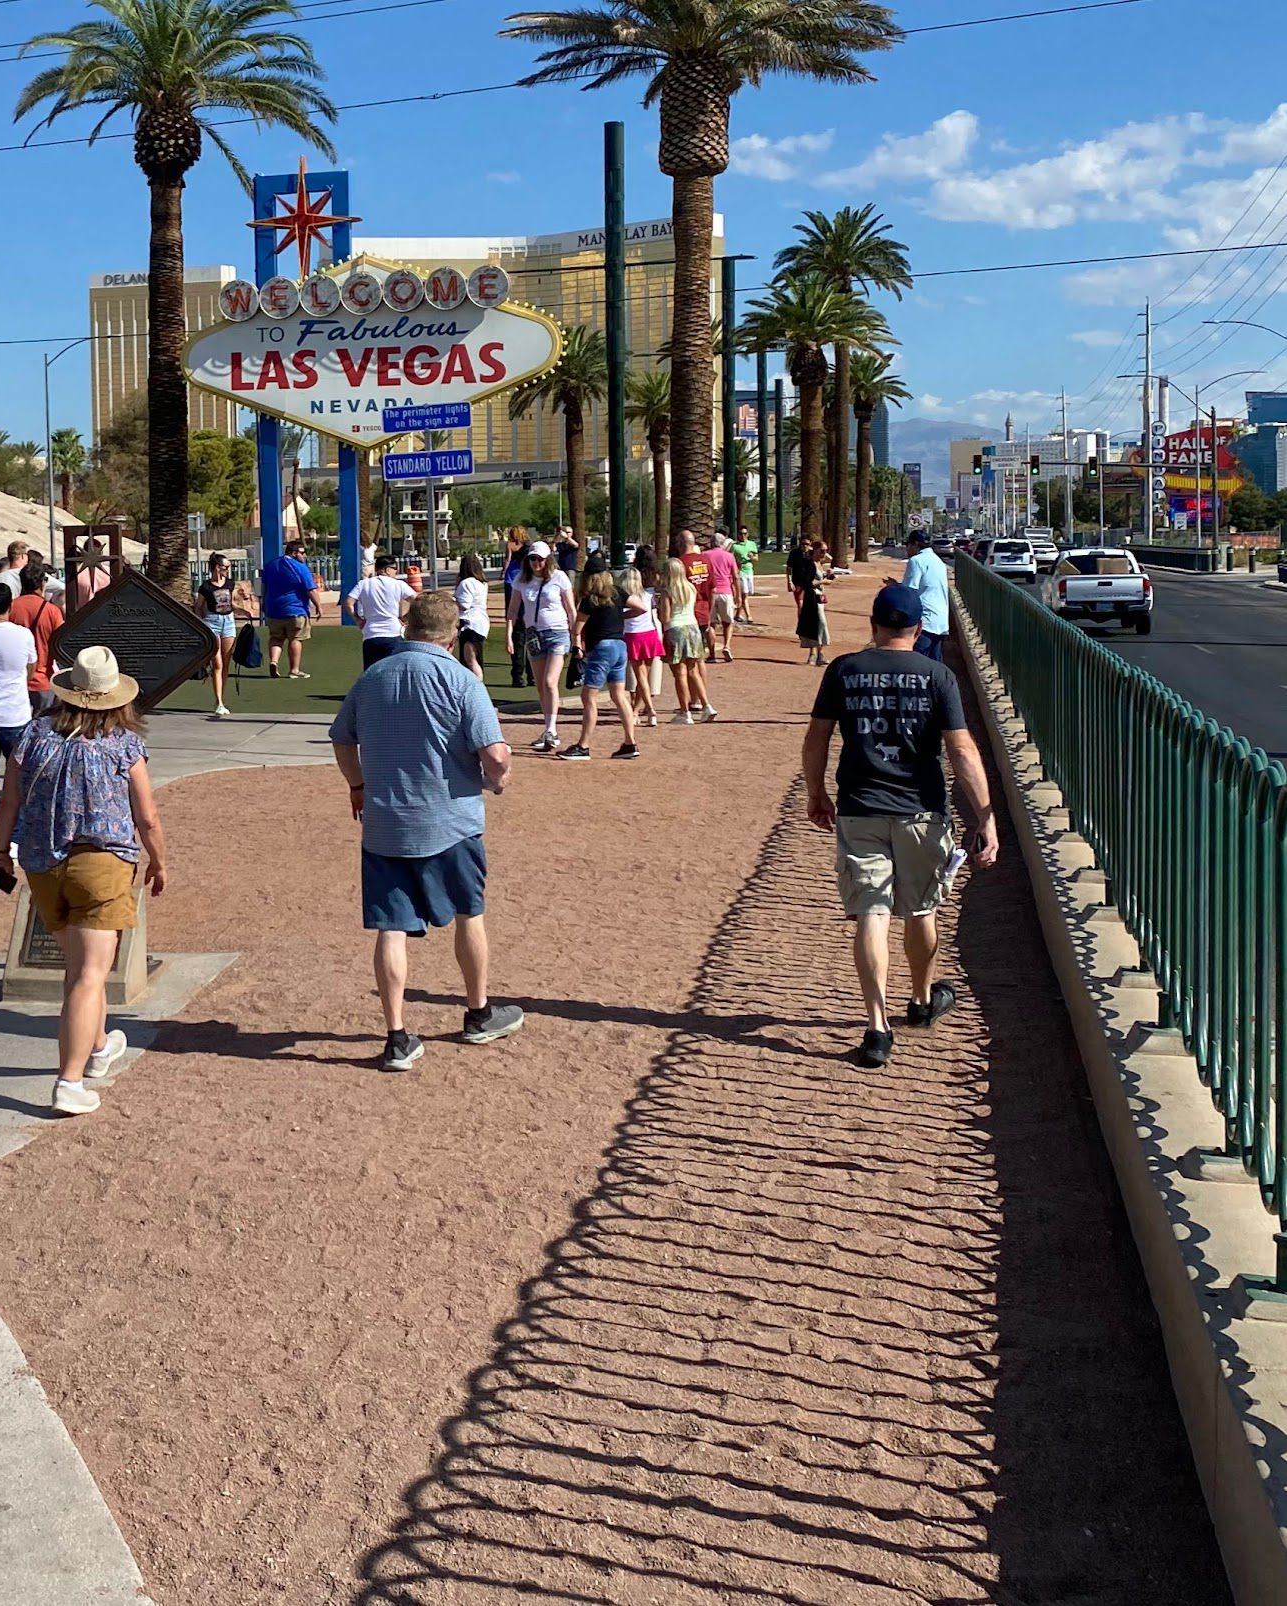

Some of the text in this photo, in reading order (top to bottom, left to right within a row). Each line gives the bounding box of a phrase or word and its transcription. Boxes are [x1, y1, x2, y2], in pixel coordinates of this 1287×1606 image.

[577, 226, 647, 247] MANLAY
[103, 273, 146, 286] DELAN
[223, 272, 499, 316] WELCOME
[257, 316, 469, 346] TO Fabulous
[231, 342, 507, 391] LAS VEGAS
[385, 405, 468, 420] The perimeter lights
[395, 420, 406, 428] on
[409, 418, 422, 427] the
[425, 418, 442, 427] sign
[1169, 437, 1209, 450] HALL
[388, 455, 470, 474] STANDARD YELLOW
[1169, 451, 1213, 463] FAME
[843, 674, 931, 690] WHISKEY
[845, 695, 930, 712] MADE ME
[857, 718, 917, 735] DO IT
